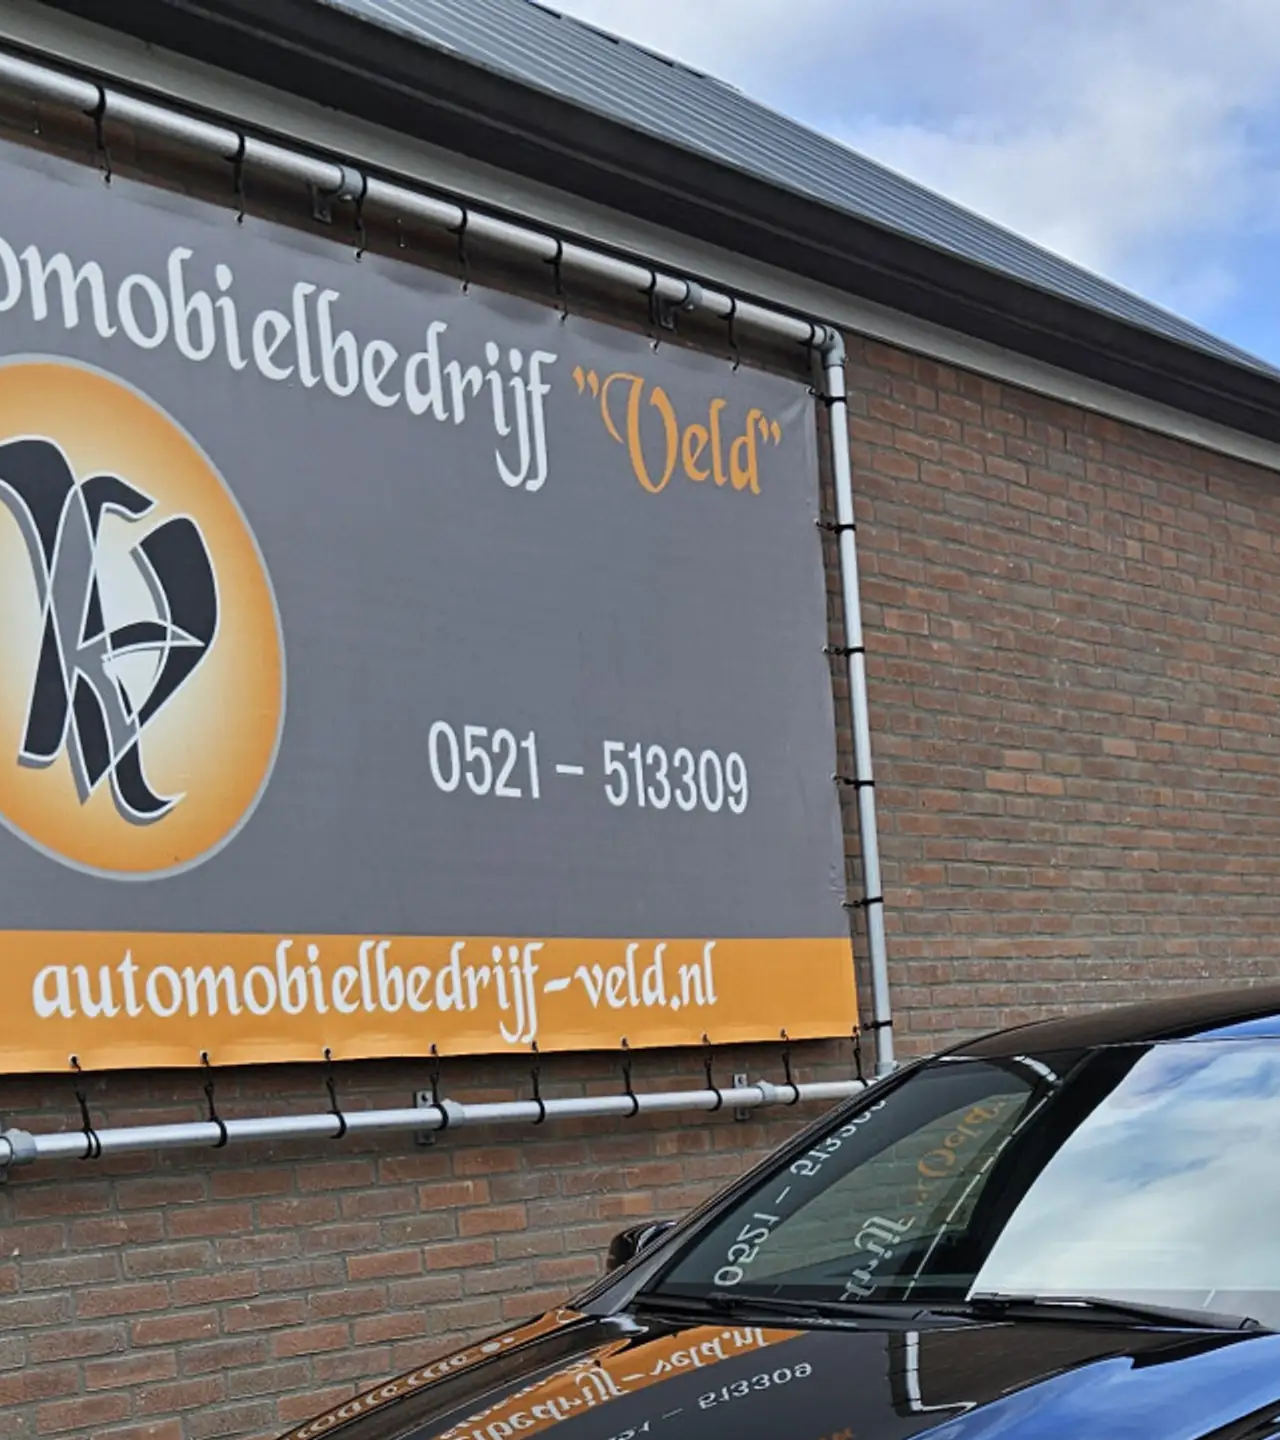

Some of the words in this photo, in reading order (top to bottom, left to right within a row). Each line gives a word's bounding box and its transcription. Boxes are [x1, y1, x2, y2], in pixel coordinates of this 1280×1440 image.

[427, 720, 541, 800] 0521
[602, 739, 749, 815] 513309
[32, 939, 718, 1044] automobielbedrijf-veld.nl
